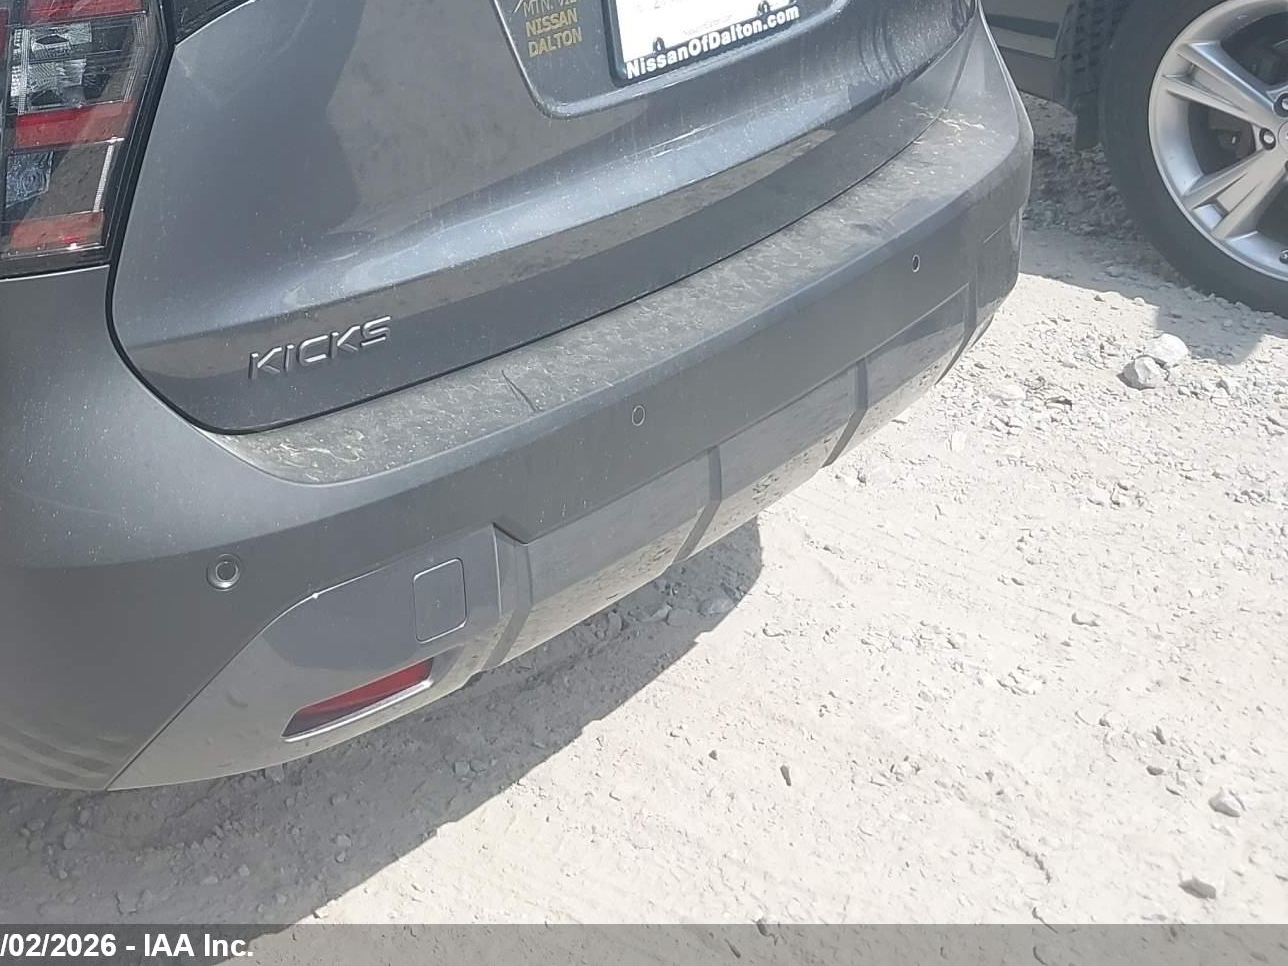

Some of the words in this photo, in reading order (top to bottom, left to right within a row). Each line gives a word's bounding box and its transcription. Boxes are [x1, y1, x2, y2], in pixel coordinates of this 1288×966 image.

[525, 7, 578, 37] NISSAN
[528, 26, 583, 58] DALTON
[625, 5, 800, 80] NissanOfDalton.com
[248, 315, 392, 380] KICKS
